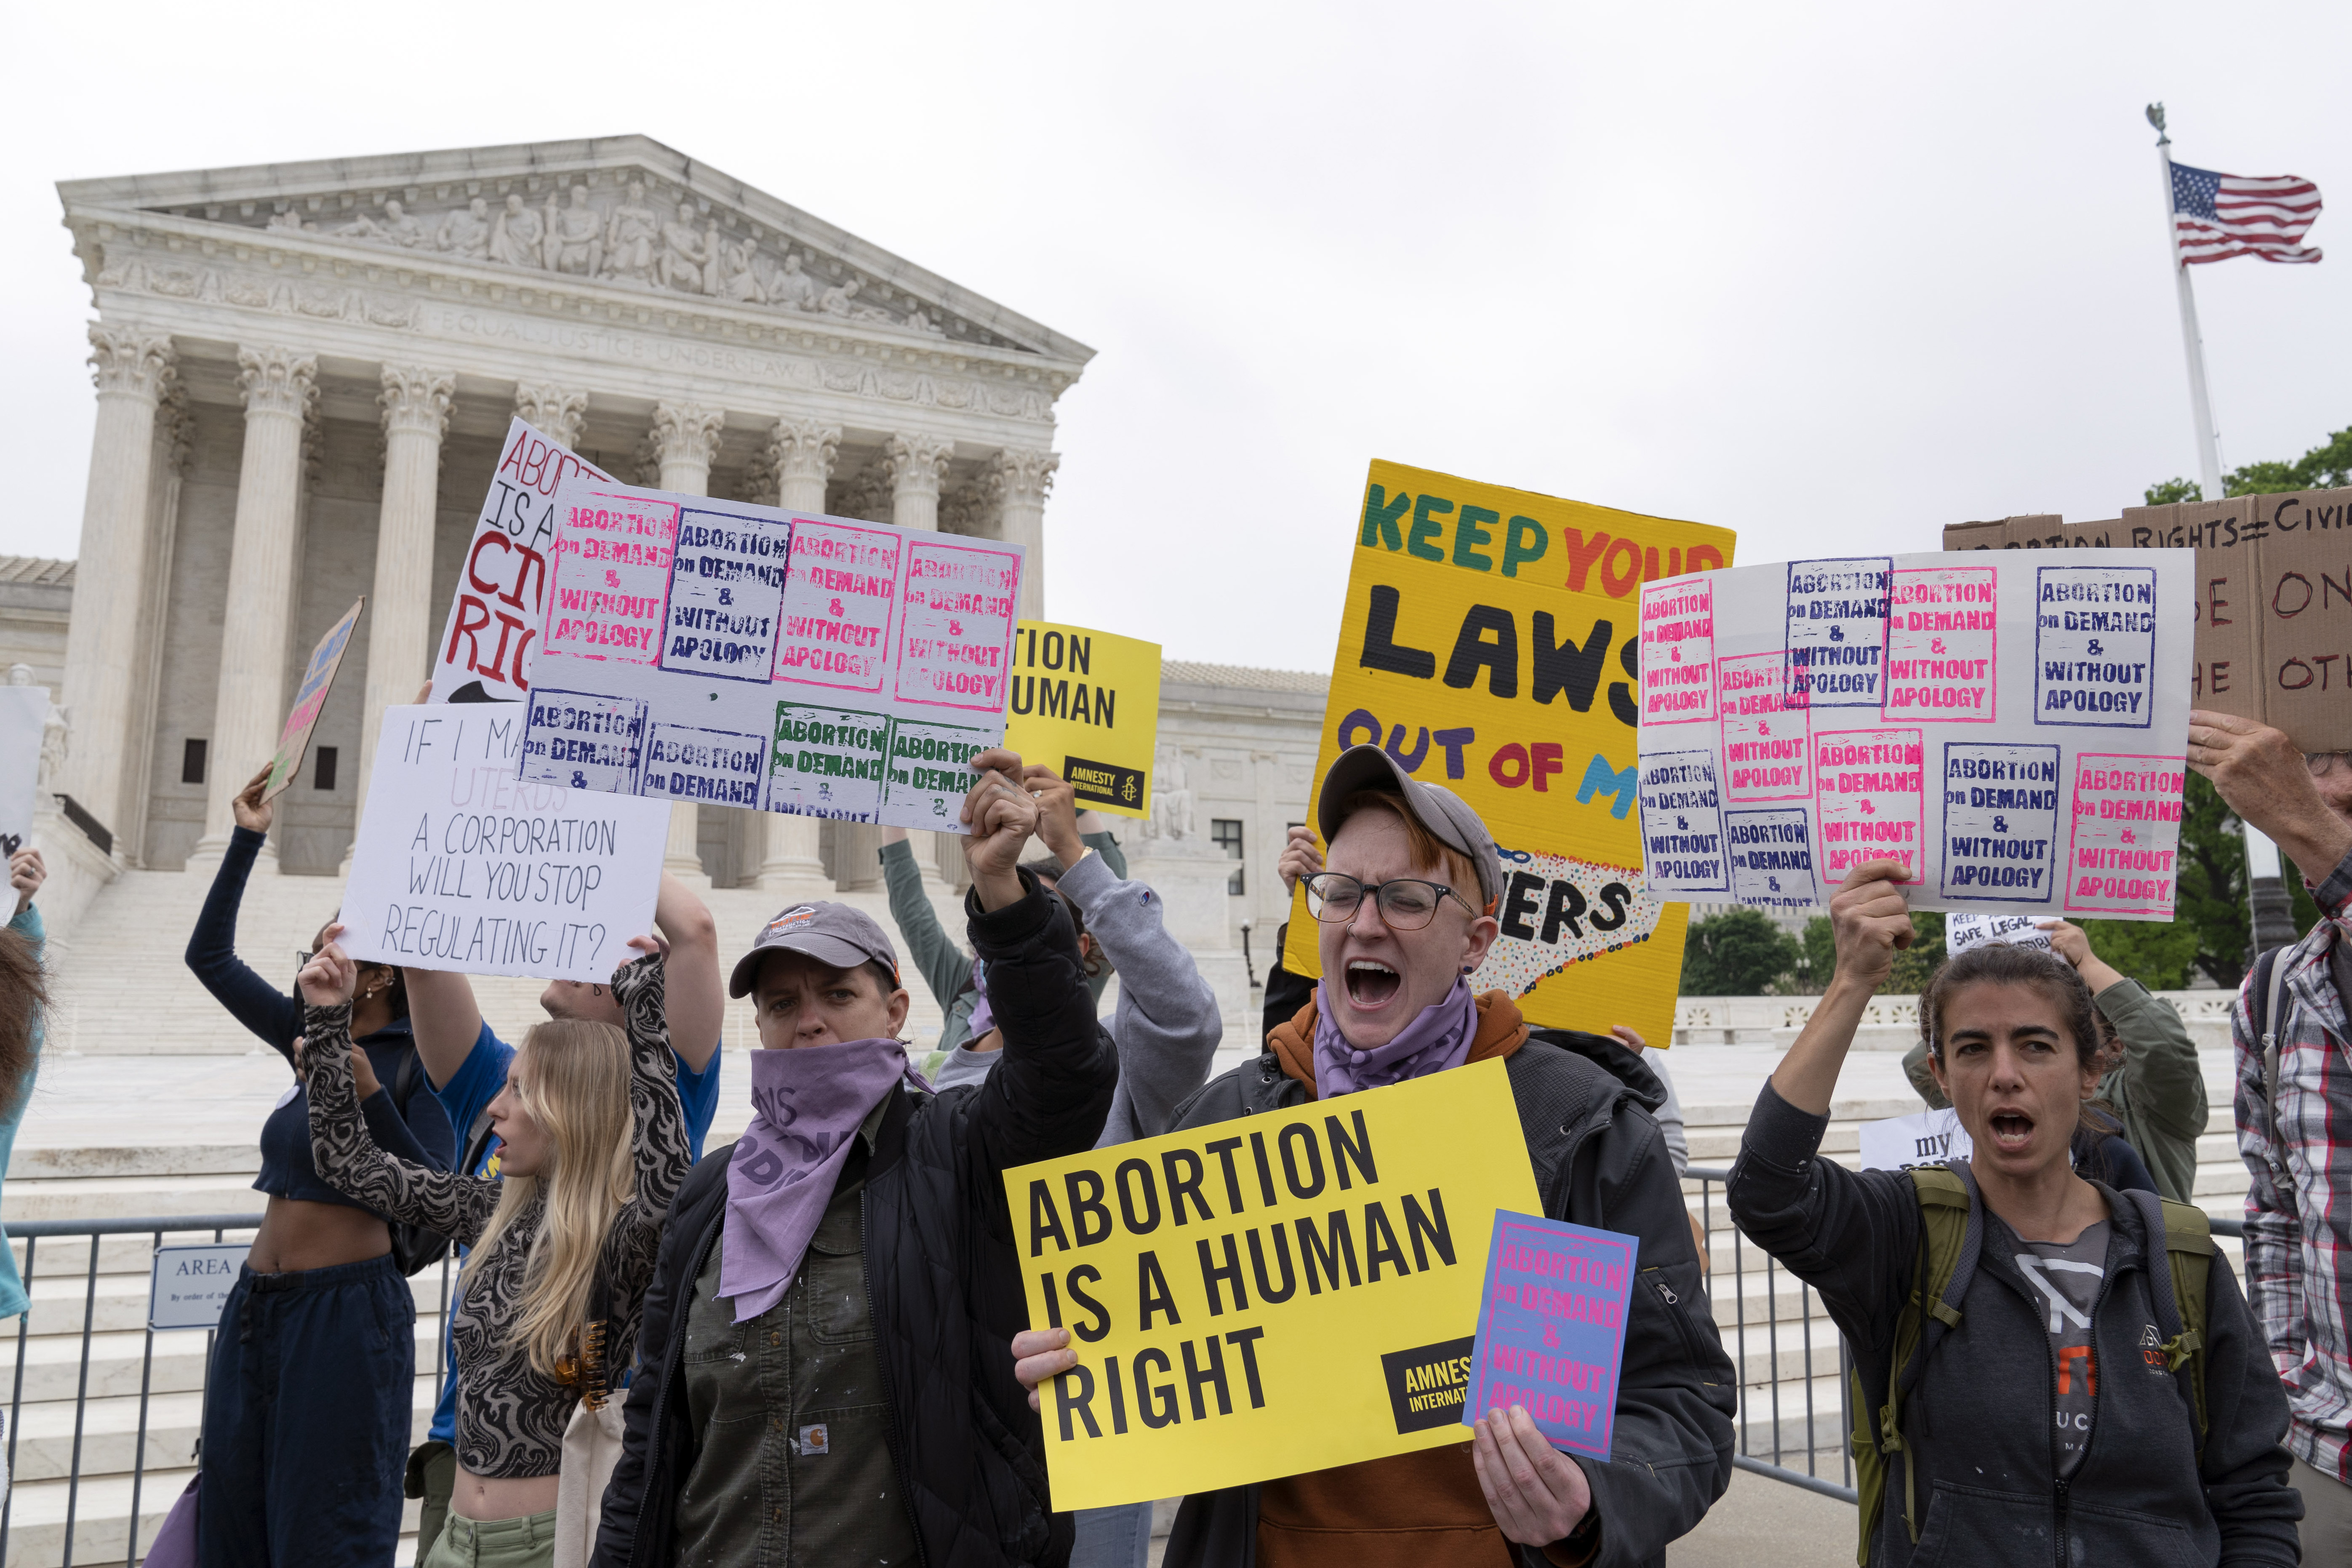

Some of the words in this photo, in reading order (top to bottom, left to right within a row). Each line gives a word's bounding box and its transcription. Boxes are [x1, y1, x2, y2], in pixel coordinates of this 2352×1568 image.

[441, 311, 535, 342] EQUAL
[541, 329, 643, 358] JUSTICE
[656, 343, 739, 373] UNDER
[750, 357, 797, 378] LAW
[486, 480, 531, 536] IS
[529, 504, 554, 554] A
[566, 507, 673, 540] ABORTION
[680, 525, 789, 559] ABORTION
[1361, 483, 1548, 578] KEEP
[560, 539, 579, 555] on
[583, 538, 672, 569] DEMAND
[791, 536, 895, 571] ABORTION
[603, 570, 621, 589] &
[675, 556, 695, 573] on
[700, 556, 786, 588] DEMAND
[810, 566, 895, 599] DEMAND
[911, 558, 1011, 590] ABORTION
[1792, 571, 1888, 594] ABORTION
[560, 588, 660, 620] WITHOUT
[718, 588, 734, 606] &
[930, 588, 1012, 618] DEMAND
[1890, 582, 1992, 604] ABORTION
[2041, 583, 2152, 604] ABORTION
[829, 598, 845, 618] &
[1644, 592, 1709, 621] ABORTION
[1788, 603, 1807, 618] on
[1809, 598, 1890, 620] DEMAND
[675, 606, 771, 638] WITHOUT
[787, 615, 882, 648] WITHOUT
[949, 619, 964, 636] &
[1643, 629, 1655, 644] on
[1656, 618, 1712, 644] DEMAND
[1829, 625, 1845, 642] &
[1908, 611, 1995, 631] DEMAND
[2038, 613, 2059, 629] on
[2064, 612, 2153, 633] DEMAND
[555, 619, 653, 651] APOLOGY
[1931, 637, 1947, 655] &
[2087, 639, 2104, 656] &
[670, 635, 767, 668] APOLOGY
[781, 645, 877, 677] APOLOGY
[909, 637, 1000, 668] WITHOUT
[1671, 646, 1681, 663] &
[1792, 645, 1882, 668] WITHOUT
[906, 666, 997, 697] APOLOGY
[1647, 663, 1709, 688] WITHOUT
[1890, 659, 1988, 680] WITHOUT
[2045, 661, 2146, 684] WITHOUT
[1792, 672, 1879, 695] APOLOGY
[1011, 675, 1115, 729] UMAN
[1647, 689, 1709, 714] APOLOGY
[1722, 700, 1738, 715] on
[1739, 690, 1809, 716] DEMAND
[1891, 687, 1986, 709] APOLOGY
[2044, 689, 2143, 714] APOLOGY
[531, 705, 642, 739] ABORTION
[1758, 720, 1771, 736] &
[404, 719, 443, 765] IF
[454, 719, 463, 761] I
[778, 719, 884, 752] ABORTION
[525, 739, 546, 756] on
[550, 737, 640, 768] DEMAND
[651, 739, 759, 774] ABORTION
[1337, 708, 1475, 780] OUT
[1488, 742, 1564, 792] OF
[1728, 738, 1804, 763] WITHOUT
[1819, 744, 1920, 767] ABORTION
[772, 752, 794, 768] on
[797, 750, 883, 781] DEMAND
[889, 768, 909, 785] on
[1071, 767, 1116, 787] AMNESTY
[1643, 763, 1713, 786] ABORTION
[1732, 765, 1803, 789] APOLOGY
[1948, 758, 2055, 782] ABORTION
[451, 766, 568, 812] UTERUS
[571, 770, 588, 789] &
[645, 773, 666, 790] on
[669, 772, 758, 805] DEMAND
[818, 782, 833, 801] &
[1070, 780, 1114, 796] INTERNATIONAL
[1818, 777, 1835, 792] on
[1838, 771, 1921, 793] DEMAND
[2079, 769, 2185, 794] ABORTION
[1642, 794, 1655, 809] on
[1658, 789, 1718, 810] DEMAND
[1860, 799, 1876, 815] &
[1946, 790, 1966, 805] on
[1971, 787, 2056, 810] DEMAND
[2076, 801, 2096, 816] on
[2100, 800, 2183, 822] DEMAND
[411, 813, 428, 852] A
[445, 813, 616, 856] CORPORATION
[1677, 814, 1689, 831] &
[1730, 823, 1805, 845] ABORTION
[1824, 821, 1916, 843] WITHOUT
[1992, 815, 2009, 833] &
[1650, 833, 1718, 854] WITHOUT
[2120, 827, 2137, 844] &
[1732, 853, 1747, 868] on
[1748, 850, 1811, 871] DEMAND
[1952, 837, 2048, 861] WITHOUT
[2078, 848, 2175, 872] WITHOUT
[409, 855, 472, 898] WILL
[1654, 859, 1720, 879] APOLOGY
[1951, 865, 2044, 889] APOLOGY
[1768, 876, 1781, 893] &
[1501, 871, 1632, 944] ERS
[381, 904, 548, 965] REGULATING
[556, 922, 606, 971] IT?
[1954, 926, 1986, 947] SAFE,
[1990, 916, 2036, 938] LEGAL,
[1915, 1132, 1951, 1158] my
[1029, 1109, 1379, 1259] ABORTION
[176, 1259, 232, 1276] AREA
[1040, 1264, 1112, 1343] IS
[1138, 1250, 1182, 1332] A
[1195, 1187, 1458, 1317] HUMAN
[1501, 1243, 1624, 1292] ABORTION
[171, 1294, 181, 1303] By
[184, 1292, 203, 1301] order
[206, 1292, 214, 1300] of
[1494, 1283, 1518, 1304] on
[1521, 1283, 1620, 1329] DEMAND
[1542, 1324, 1561, 1350] &
[1405, 1355, 1472, 1393] AMNES
[1493, 1343, 1606, 1394] WITHOUT
[1053, 1325, 1266, 1442] RIGHT
[1409, 1386, 1468, 1413] INTERNAT
[1488, 1381, 1599, 1432] APOLOGY
